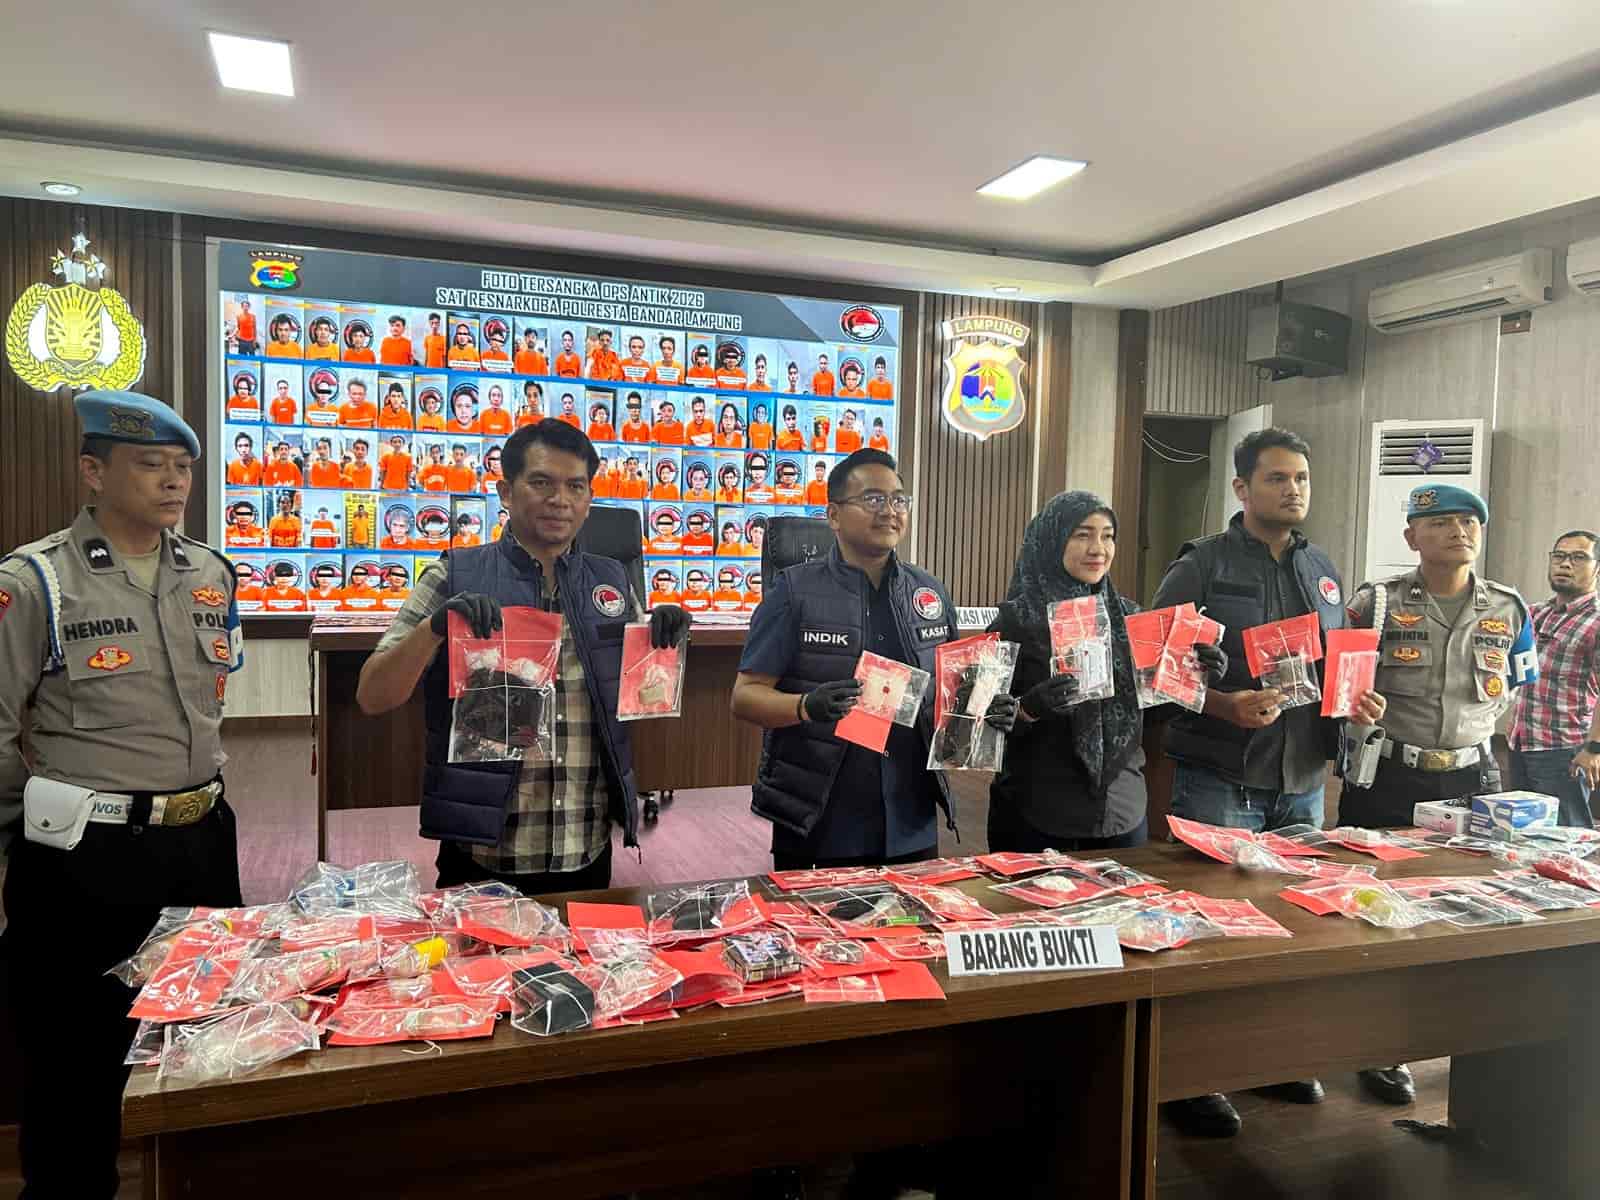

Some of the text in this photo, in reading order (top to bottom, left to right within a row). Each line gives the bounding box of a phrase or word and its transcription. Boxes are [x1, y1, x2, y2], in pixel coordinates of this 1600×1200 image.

[482, 271, 519, 290] FOTO
[520, 275, 600, 298] TERSANGKA
[601, 283, 629, 300] OPS
[630, 286, 669, 305] ANTIK
[437, 288, 742, 331] SAT RESNARKOBA POLRESTA BANDAR LAMPUNG
[954, 319, 1024, 339] LAMPUNG
[63, 617, 138, 641] HENDRA
[803, 631, 849, 646] INDIK
[921, 625, 948, 639] KASAT
[960, 928, 1098, 971] BARANG BUKTI
